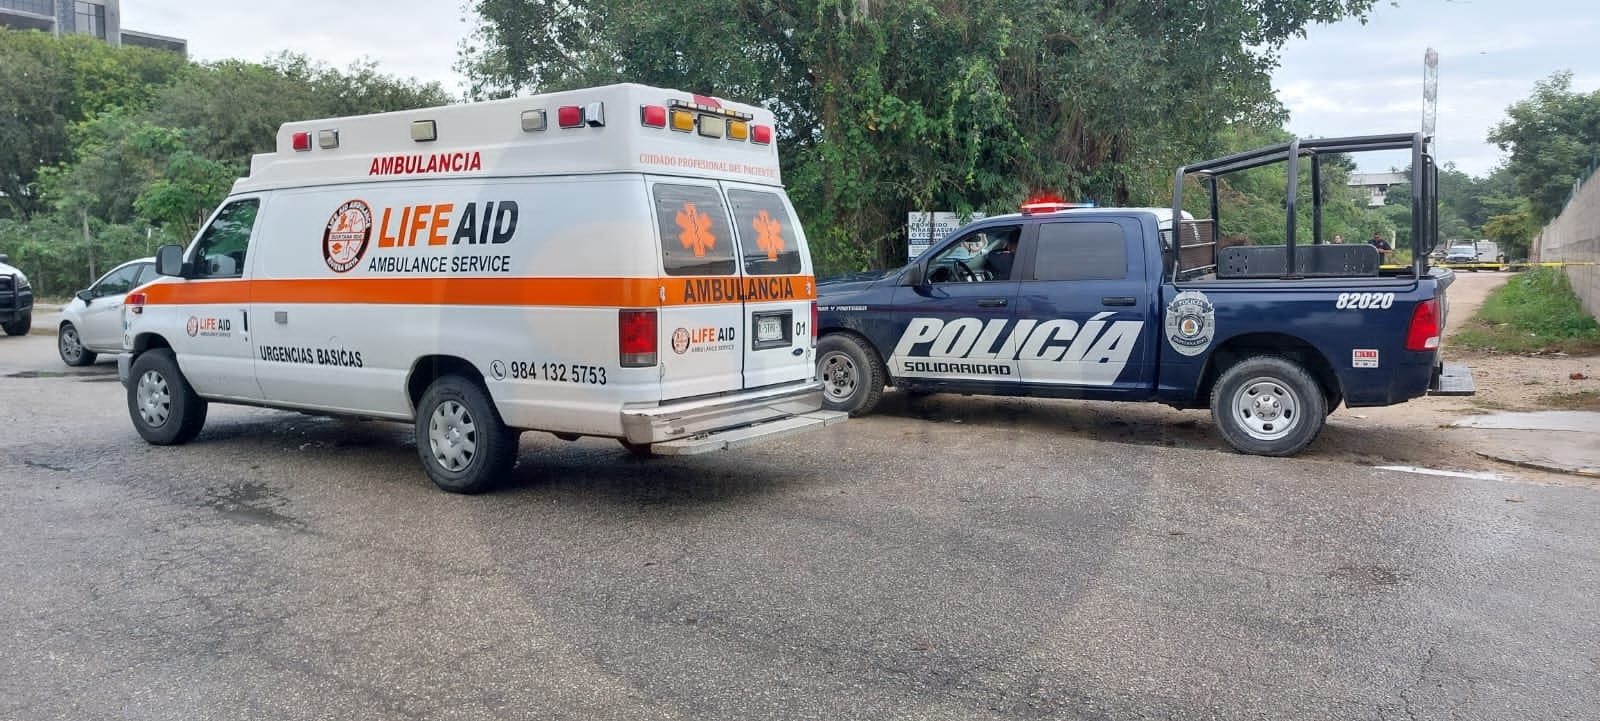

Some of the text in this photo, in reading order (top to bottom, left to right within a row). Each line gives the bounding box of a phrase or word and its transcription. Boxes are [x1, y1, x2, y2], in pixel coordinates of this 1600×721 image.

[369, 151, 481, 176] AMBULANCIA
[640, 153, 676, 165] CUIDADO
[678, 157, 727, 171] PROFESIONAL
[378, 200, 519, 248] LIFE AID
[368, 255, 511, 273] AMBULANCE SERVICE
[684, 277, 794, 303] AMBULANCIA
[1336, 292, 1395, 310] 82020
[200, 318, 216, 330] LIFE
[218, 319, 231, 331] AID
[796, 321, 806, 336] 01
[691, 327, 715, 343] LIFE
[717, 326, 735, 341] AID
[898, 311, 1144, 363] POLICÍA
[259, 345, 314, 364] URGENCIAS
[511, 361, 607, 385] 984 132 5753
[903, 361, 1011, 376] SOLIDARIDAD
